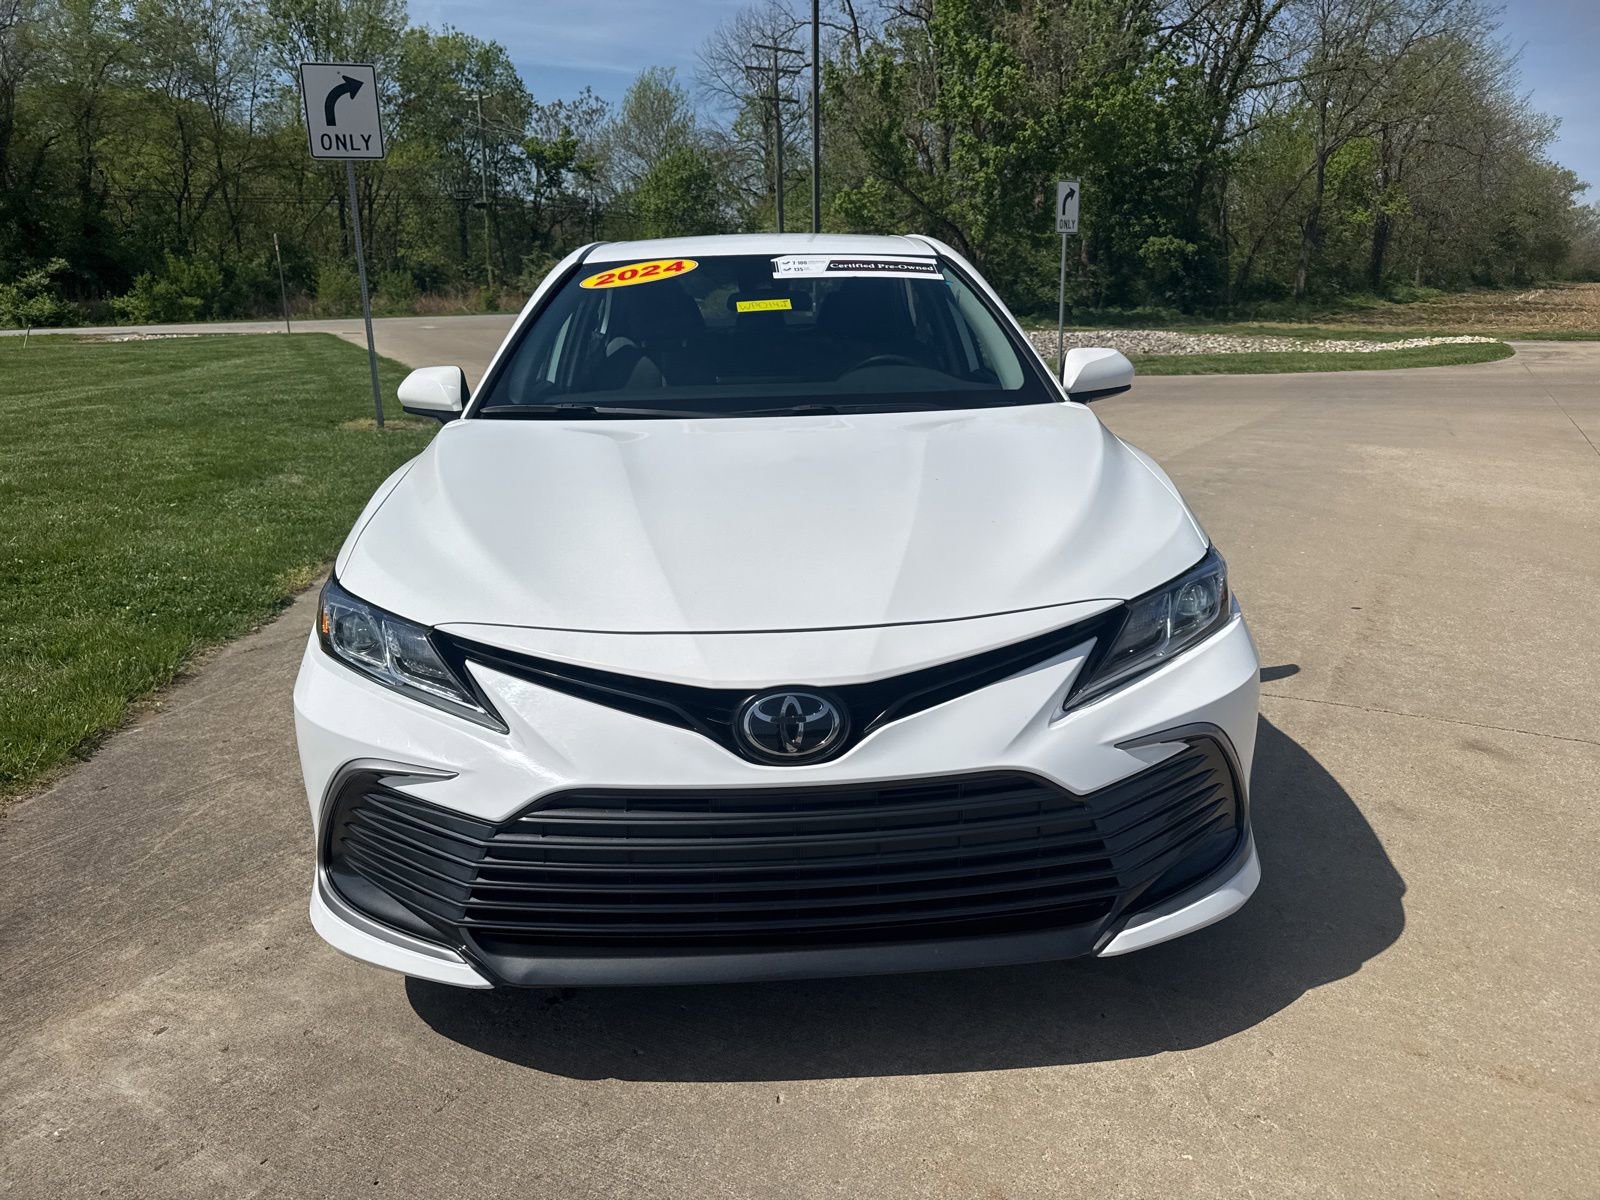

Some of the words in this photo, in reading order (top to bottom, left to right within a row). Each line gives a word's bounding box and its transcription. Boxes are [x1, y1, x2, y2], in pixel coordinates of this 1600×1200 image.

[321, 133, 372, 151] ONLY
[1059, 218, 1076, 230] ONLY
[594, 260, 686, 286] 2024
[878, 263, 934, 271] Pre-Owned
